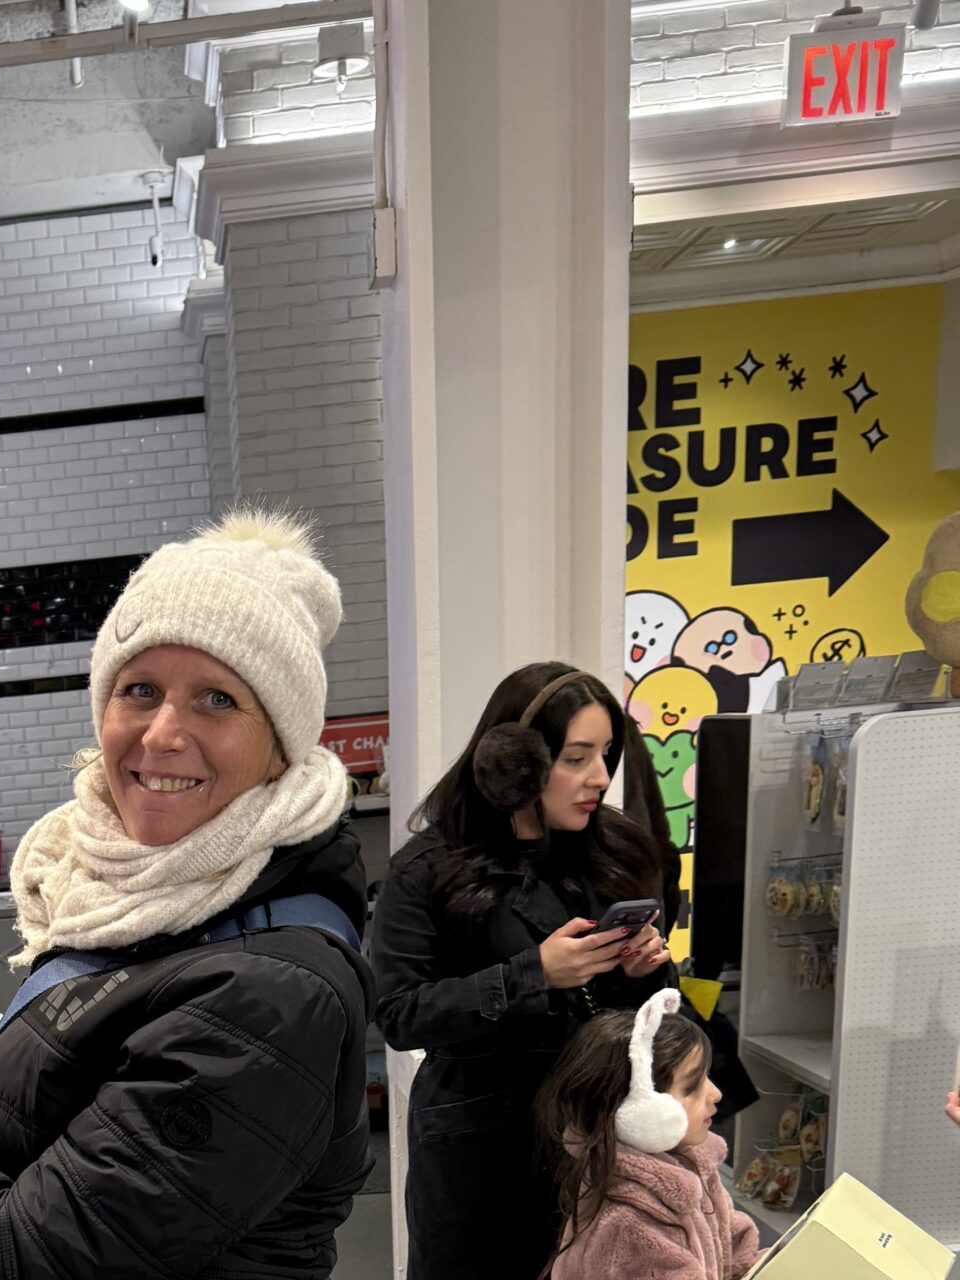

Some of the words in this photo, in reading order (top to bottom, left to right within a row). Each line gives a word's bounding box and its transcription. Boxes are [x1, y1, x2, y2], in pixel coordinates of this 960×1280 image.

[801, 37, 896, 118] EXIT
[627, 416, 838, 495] SURE
[352, 736, 389, 750] CHA
